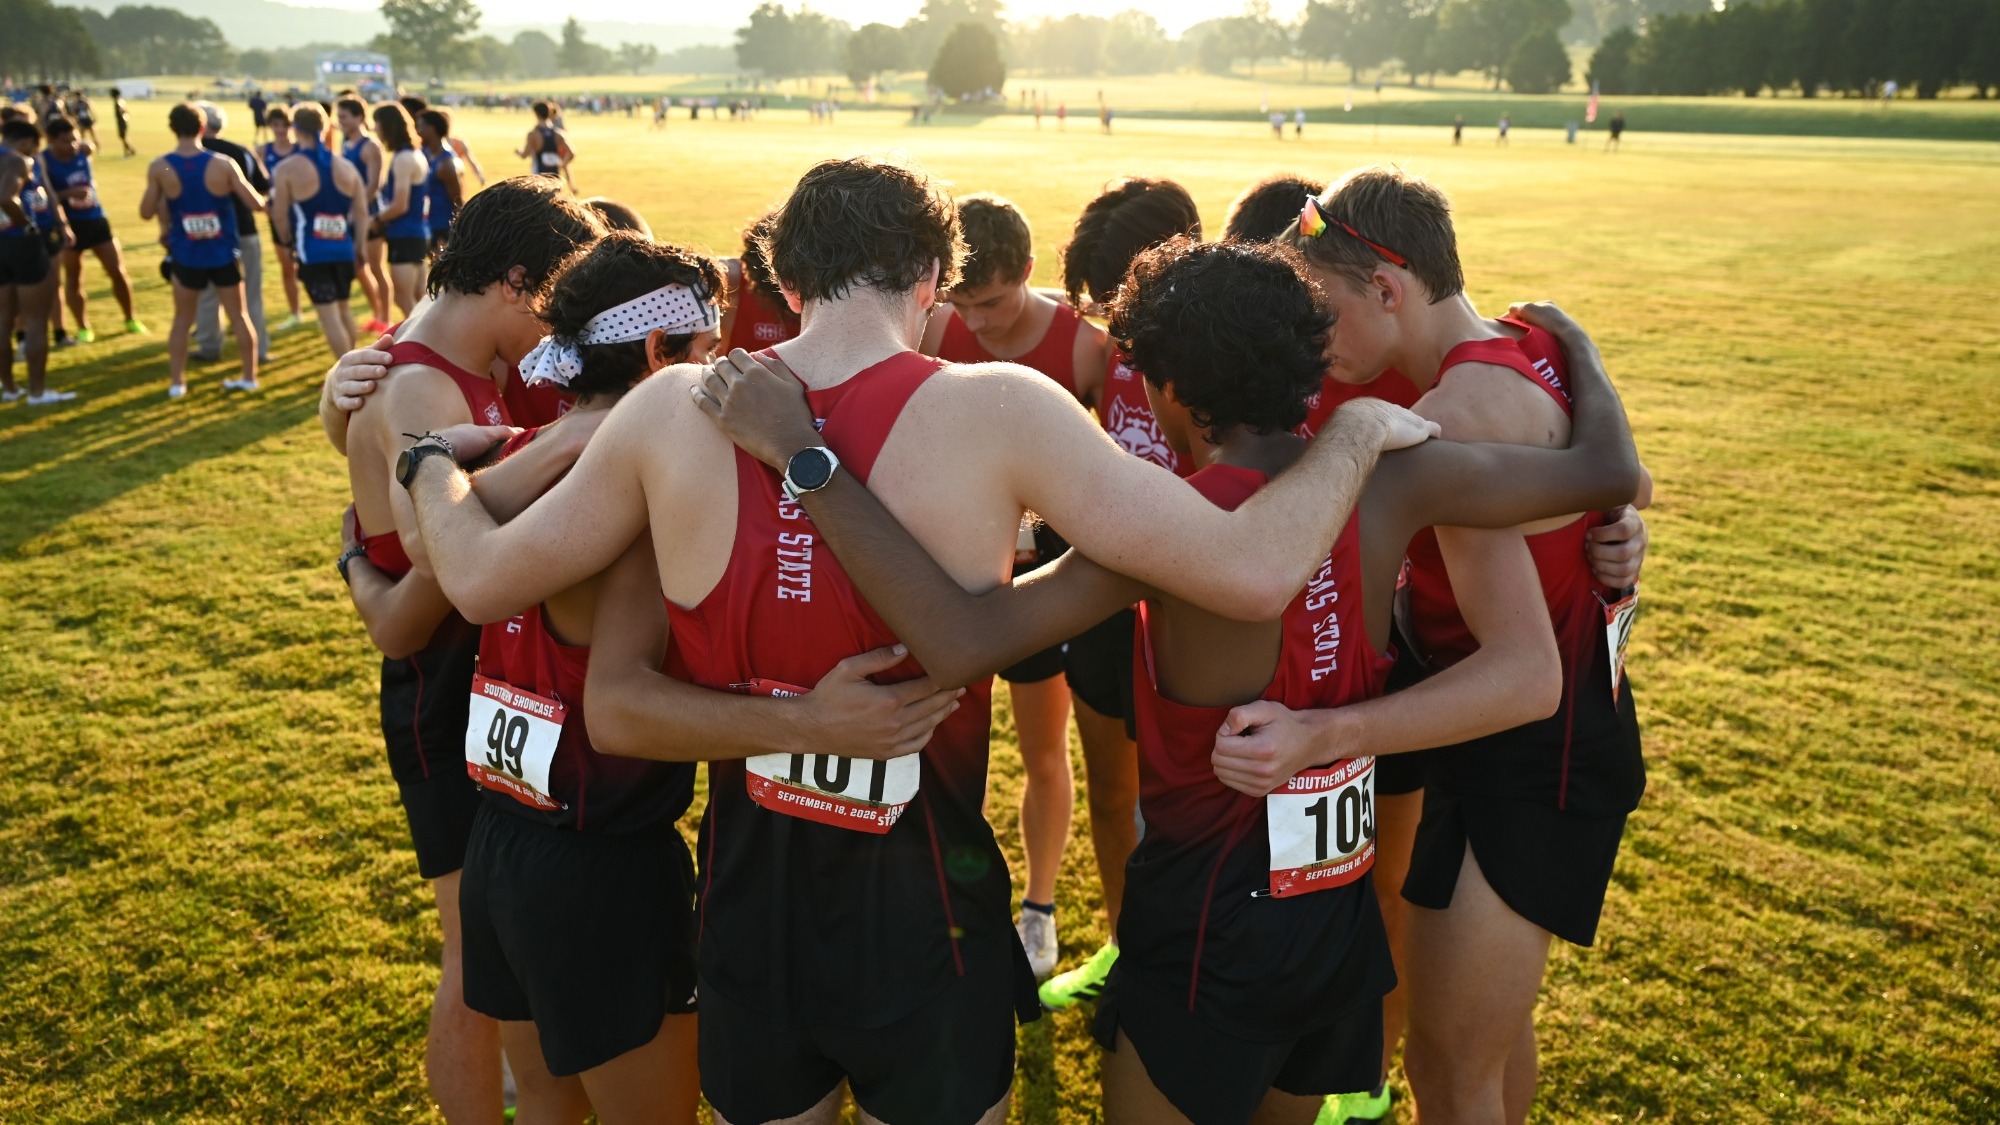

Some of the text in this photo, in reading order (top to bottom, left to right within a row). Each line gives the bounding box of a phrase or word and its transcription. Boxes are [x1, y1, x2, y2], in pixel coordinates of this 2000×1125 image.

[777, 532, 813, 602] STATE
[512, 694, 555, 718] SHOWCASE
[486, 708, 529, 779] 99
[781, 776, 793, 786] 101
[1288, 767, 1346, 790] SOUTHERN
[777, 790, 832, 812] SEPTEMBER
[834, 804, 847, 817] 18,
[849, 807, 877, 820] 2026
[1305, 769, 1373, 861] 105
[1305, 861, 1353, 881] SEPTEMBER
[1310, 862, 1323, 870] 105
